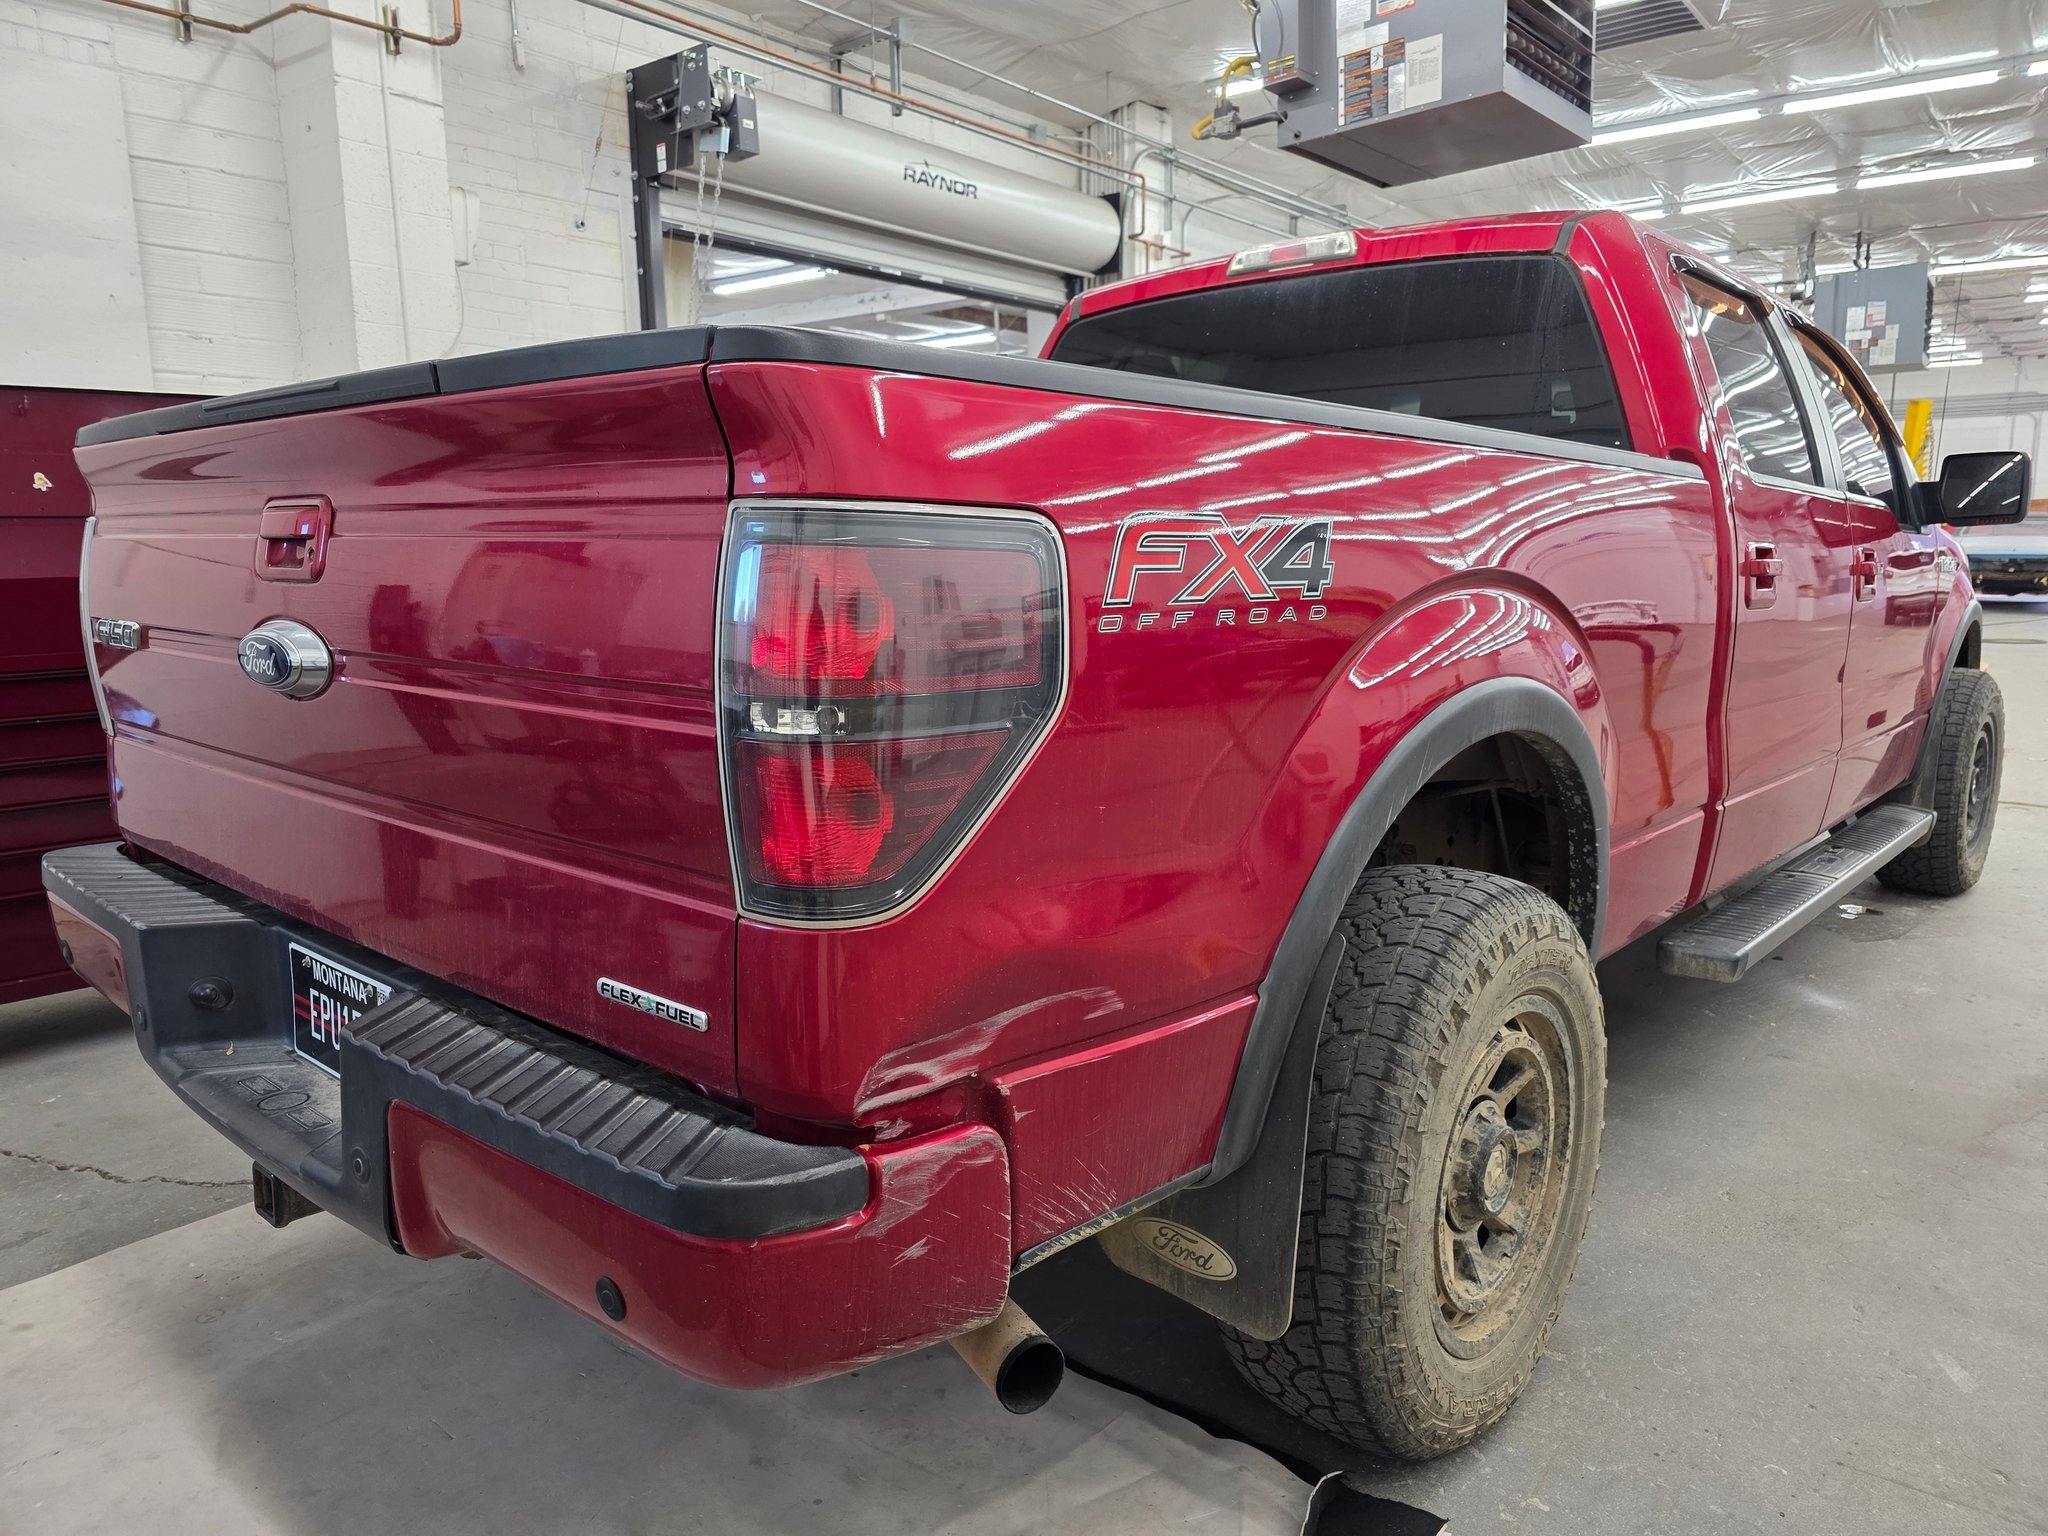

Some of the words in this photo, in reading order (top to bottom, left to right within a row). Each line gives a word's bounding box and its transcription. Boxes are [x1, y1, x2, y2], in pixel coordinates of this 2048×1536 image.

[903, 166, 978, 199] RAYNOR
[1102, 510, 1336, 608] FX4
[1098, 610, 1195, 633] OFF
[1216, 605, 1328, 626] ROAD
[243, 640, 277, 677] Ford
[311, 959, 368, 1005] MONTANA
[601, 981, 643, 1008] FLEX
[655, 1001, 701, 1029] FUEL
[309, 987, 362, 1051] EPU
[1152, 1225, 1215, 1271] Ford
